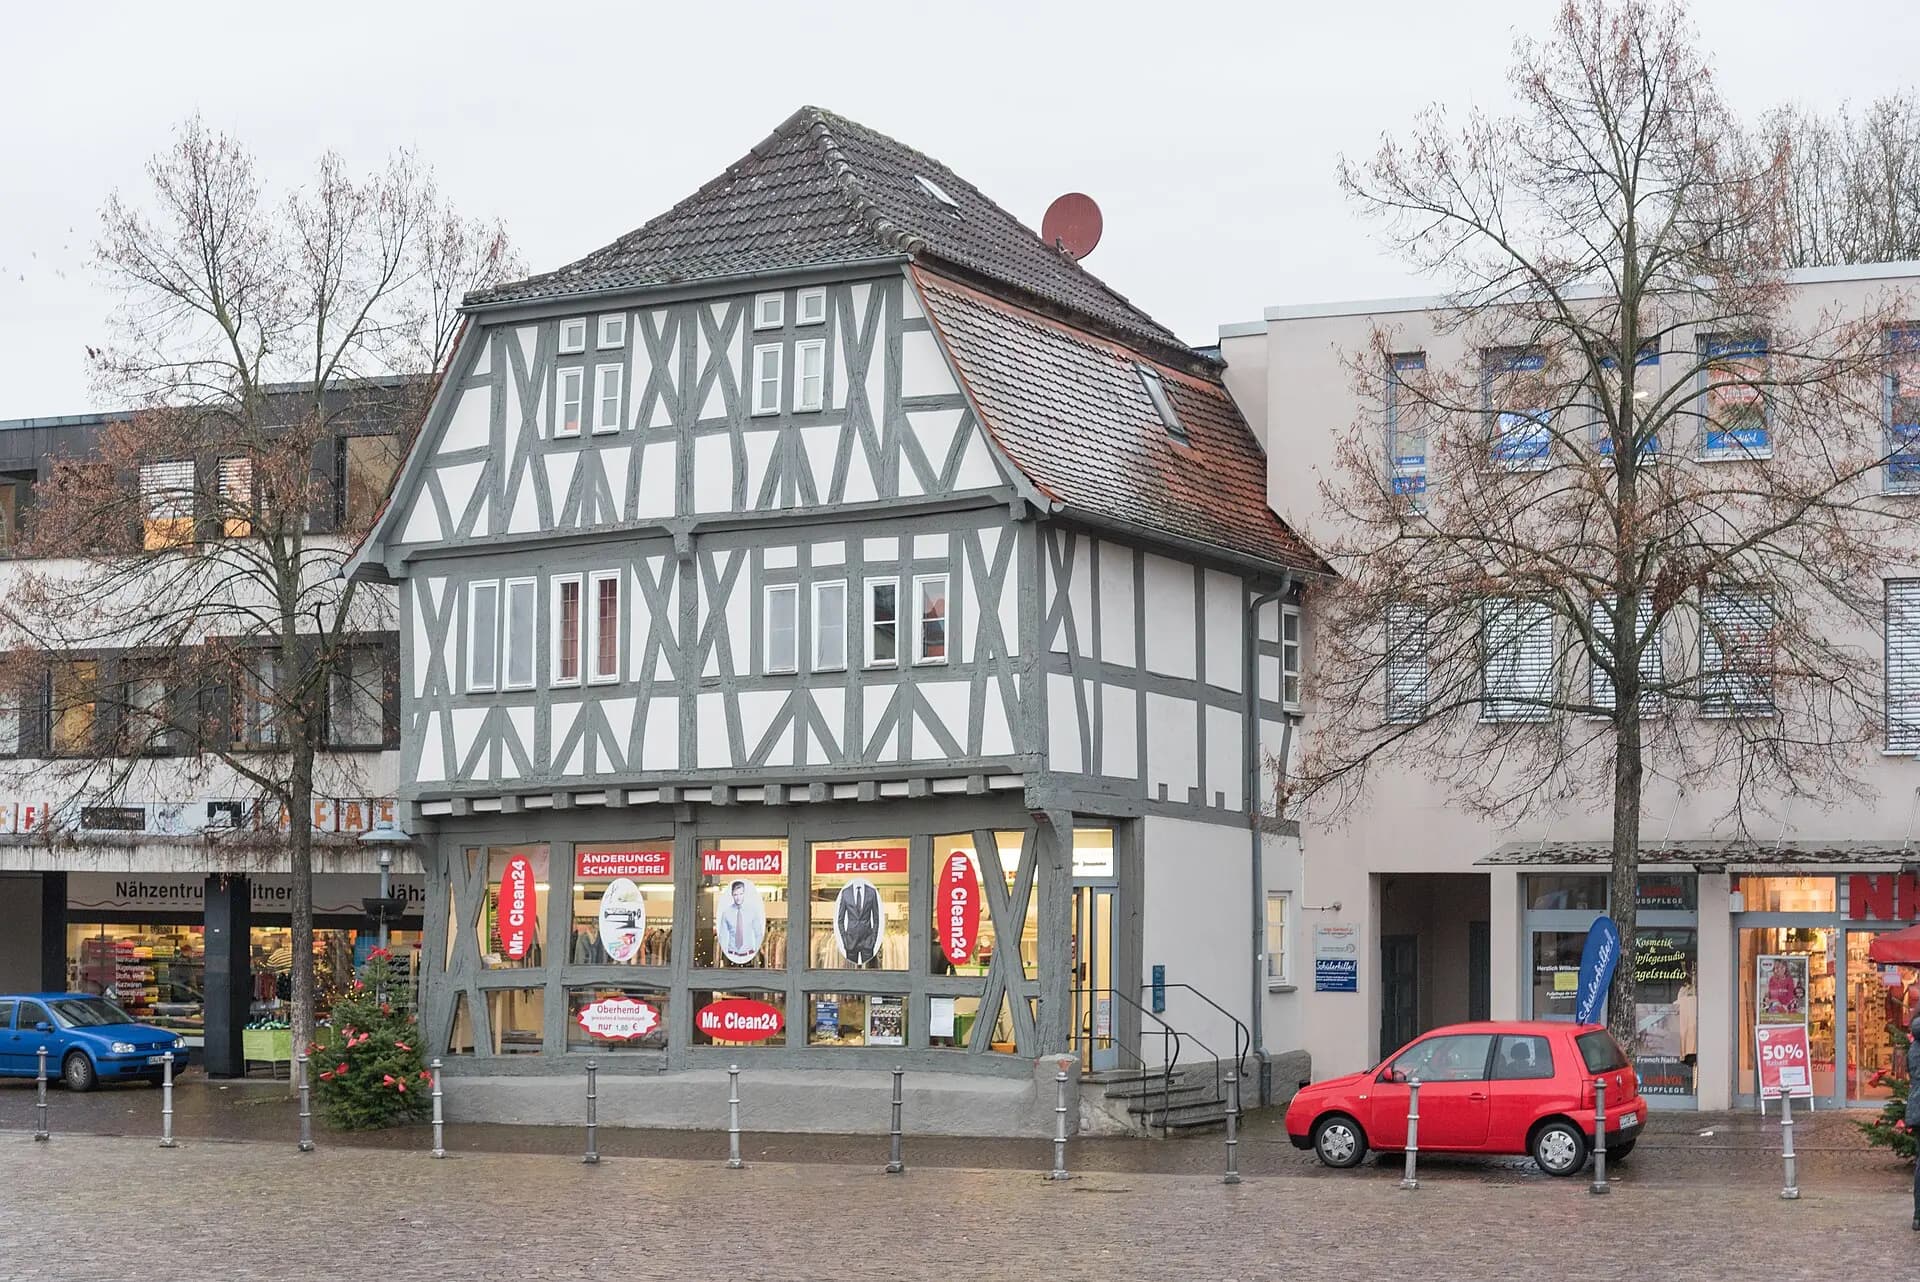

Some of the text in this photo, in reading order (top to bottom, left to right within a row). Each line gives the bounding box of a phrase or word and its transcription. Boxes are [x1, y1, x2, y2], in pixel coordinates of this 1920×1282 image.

[582, 853, 666, 863] ÄNDERUNGS-
[835, 850, 887, 860] TEXTIL-
[704, 854, 780, 871] Mr. Clean24
[835, 862, 887, 872] PFLEGE
[583, 865, 664, 875] SCHNEIDEREI
[116, 881, 293, 899] Nähzentru itner
[509, 860, 526, 955] Mr. Clean24
[951, 856, 968, 959] Mr. Clean24
[1634, 967, 1687, 982] agelstudio
[597, 1005, 640, 1014] Oberhemd
[598, 1023, 612, 1031] nur
[632, 1022, 639, 1031] €
[702, 1011, 778, 1030] Mr. Clean24
[1762, 1044, 1804, 1060] 50%
[1637, 1086, 1685, 1094] USSPFLEGE
